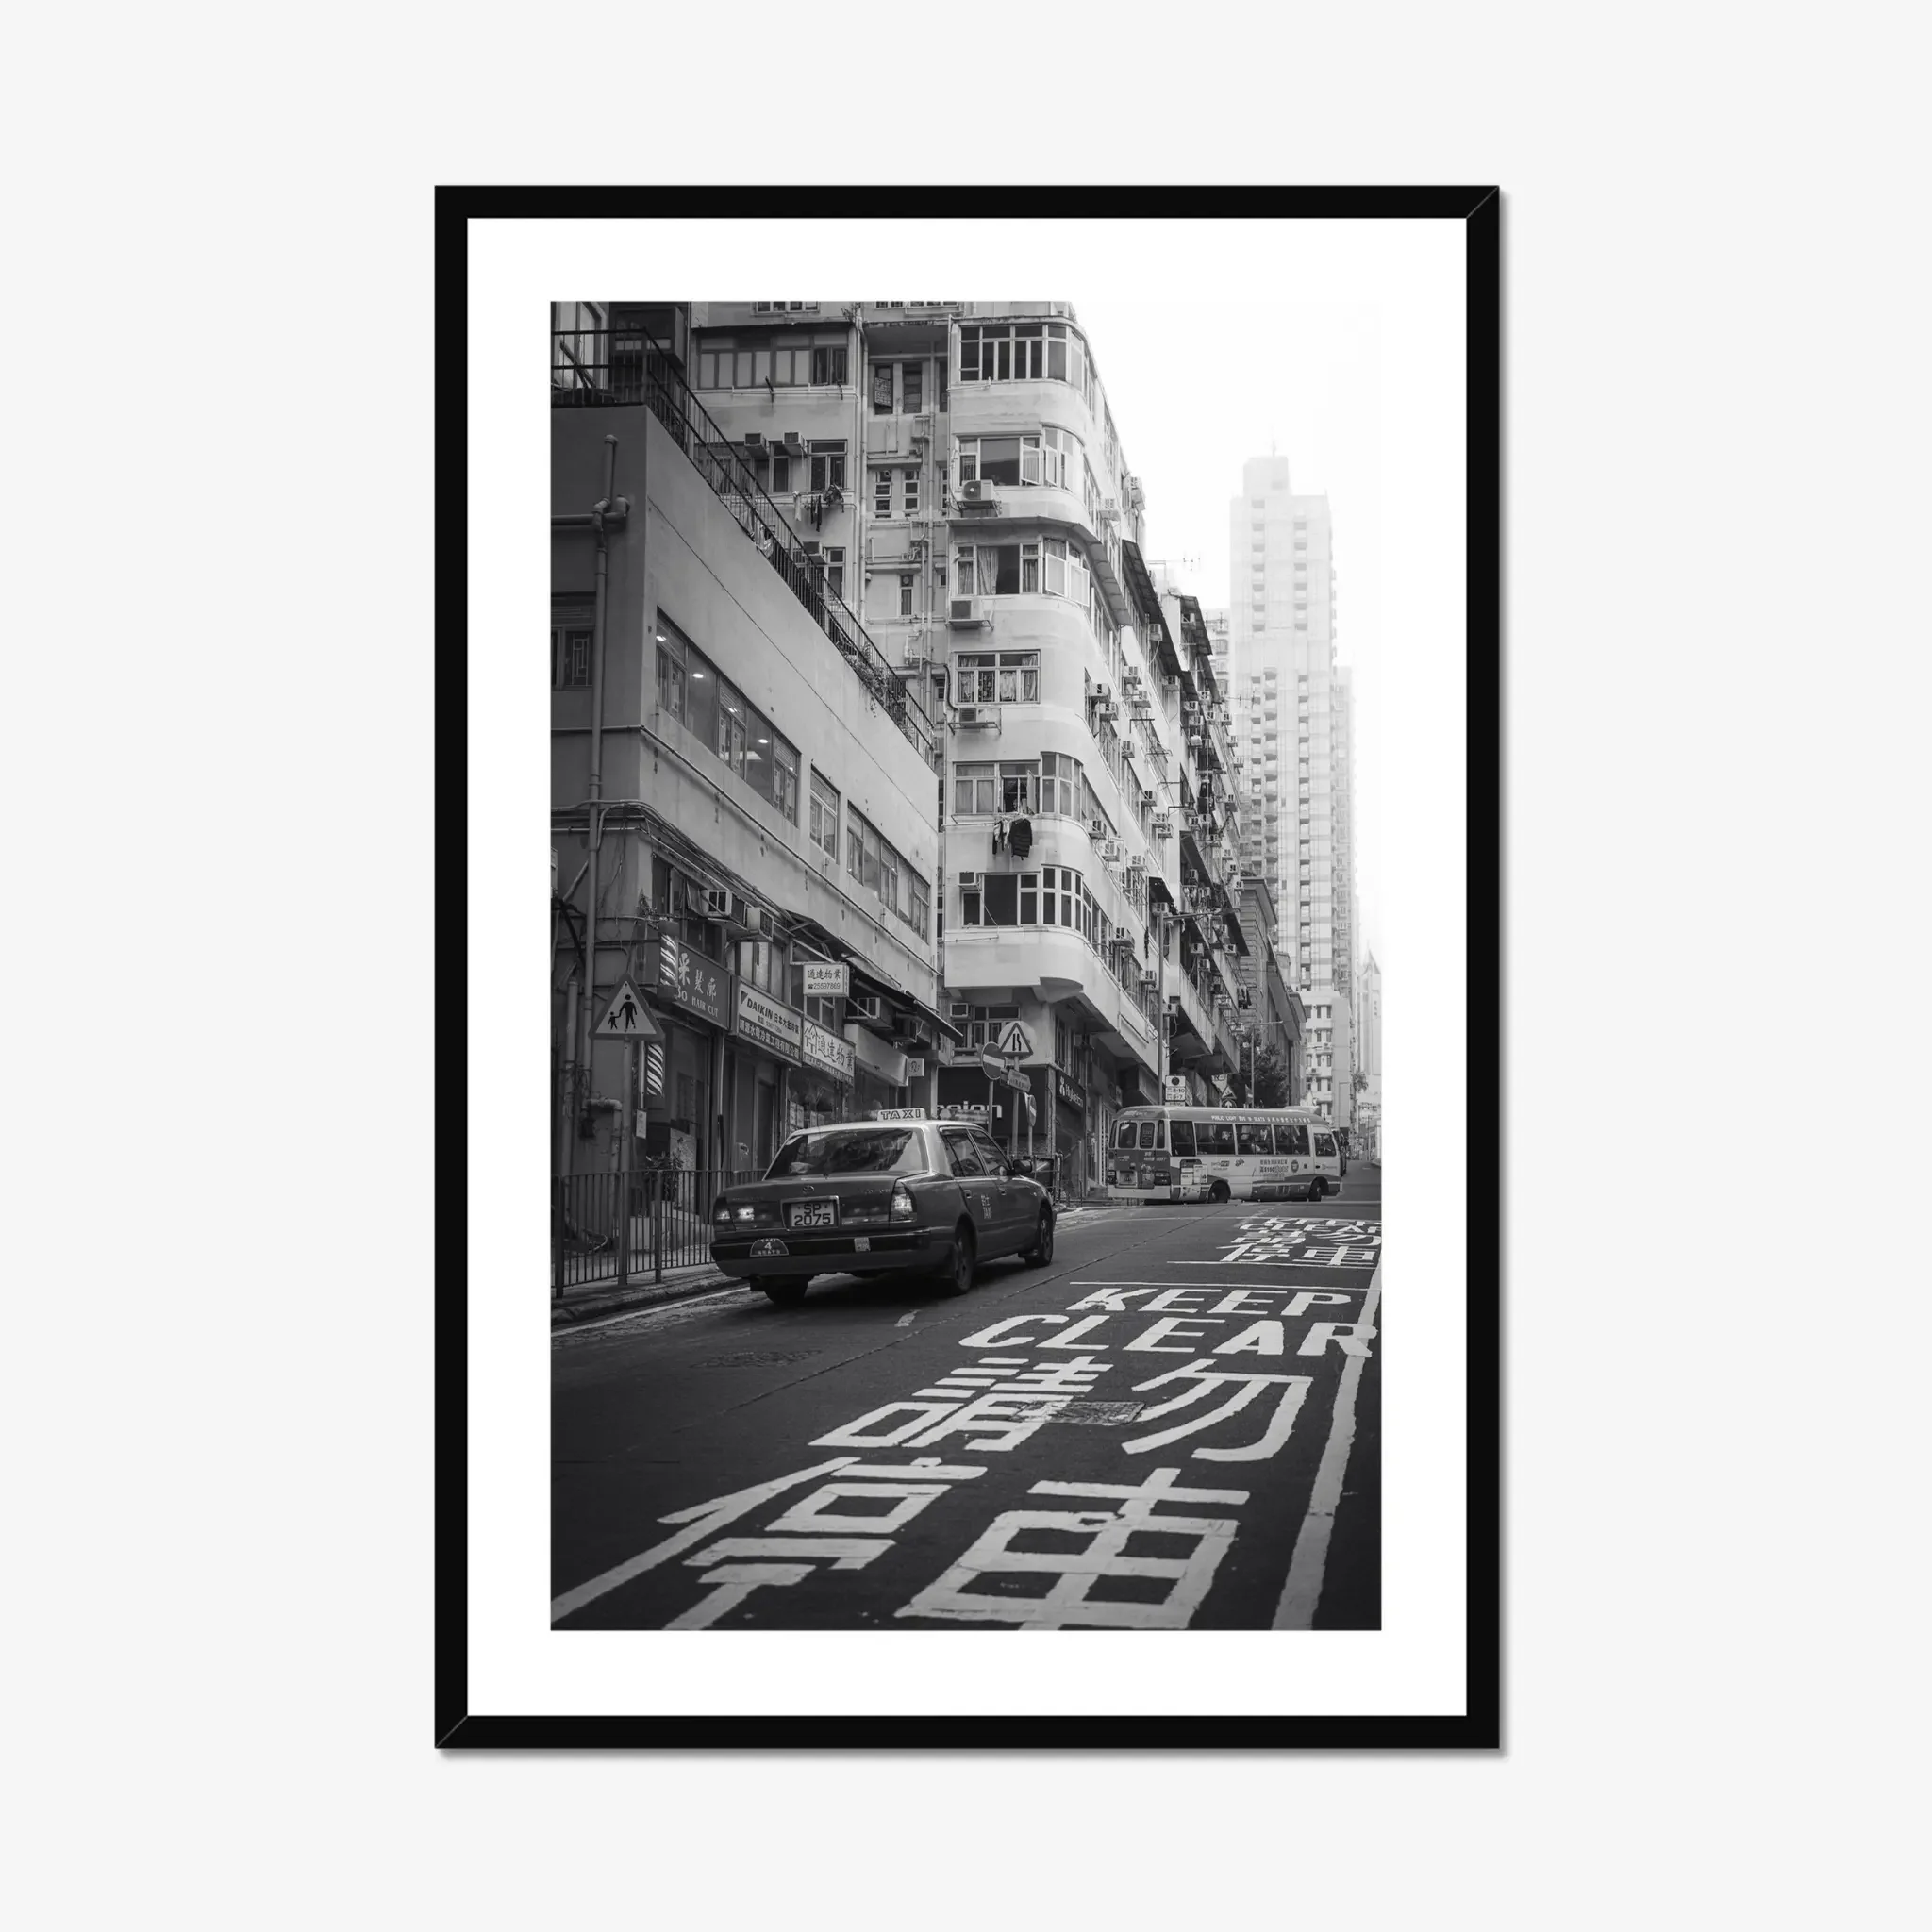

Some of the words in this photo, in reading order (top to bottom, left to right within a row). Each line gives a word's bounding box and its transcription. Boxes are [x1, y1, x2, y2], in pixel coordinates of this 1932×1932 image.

[808, 968, 841, 980] 通達物業
[691, 995, 706, 1011] HAIR
[708, 1005, 719, 1018] CUT
[746, 997, 774, 1020] DAIKIN
[818, 1035, 855, 1073] 通達物業
[880, 1108, 922, 1121] TAXI
[794, 1213, 831, 1226] 2075
[803, 1203, 822, 1217] SP
[764, 1241, 773, 1250] 4
[1066, 1288, 1352, 1316] KEEP
[958, 1314, 1378, 1357] CLEAR
[808, 1356, 1313, 1462] 請勿
[551, 1457, 1250, 1630] 停車
